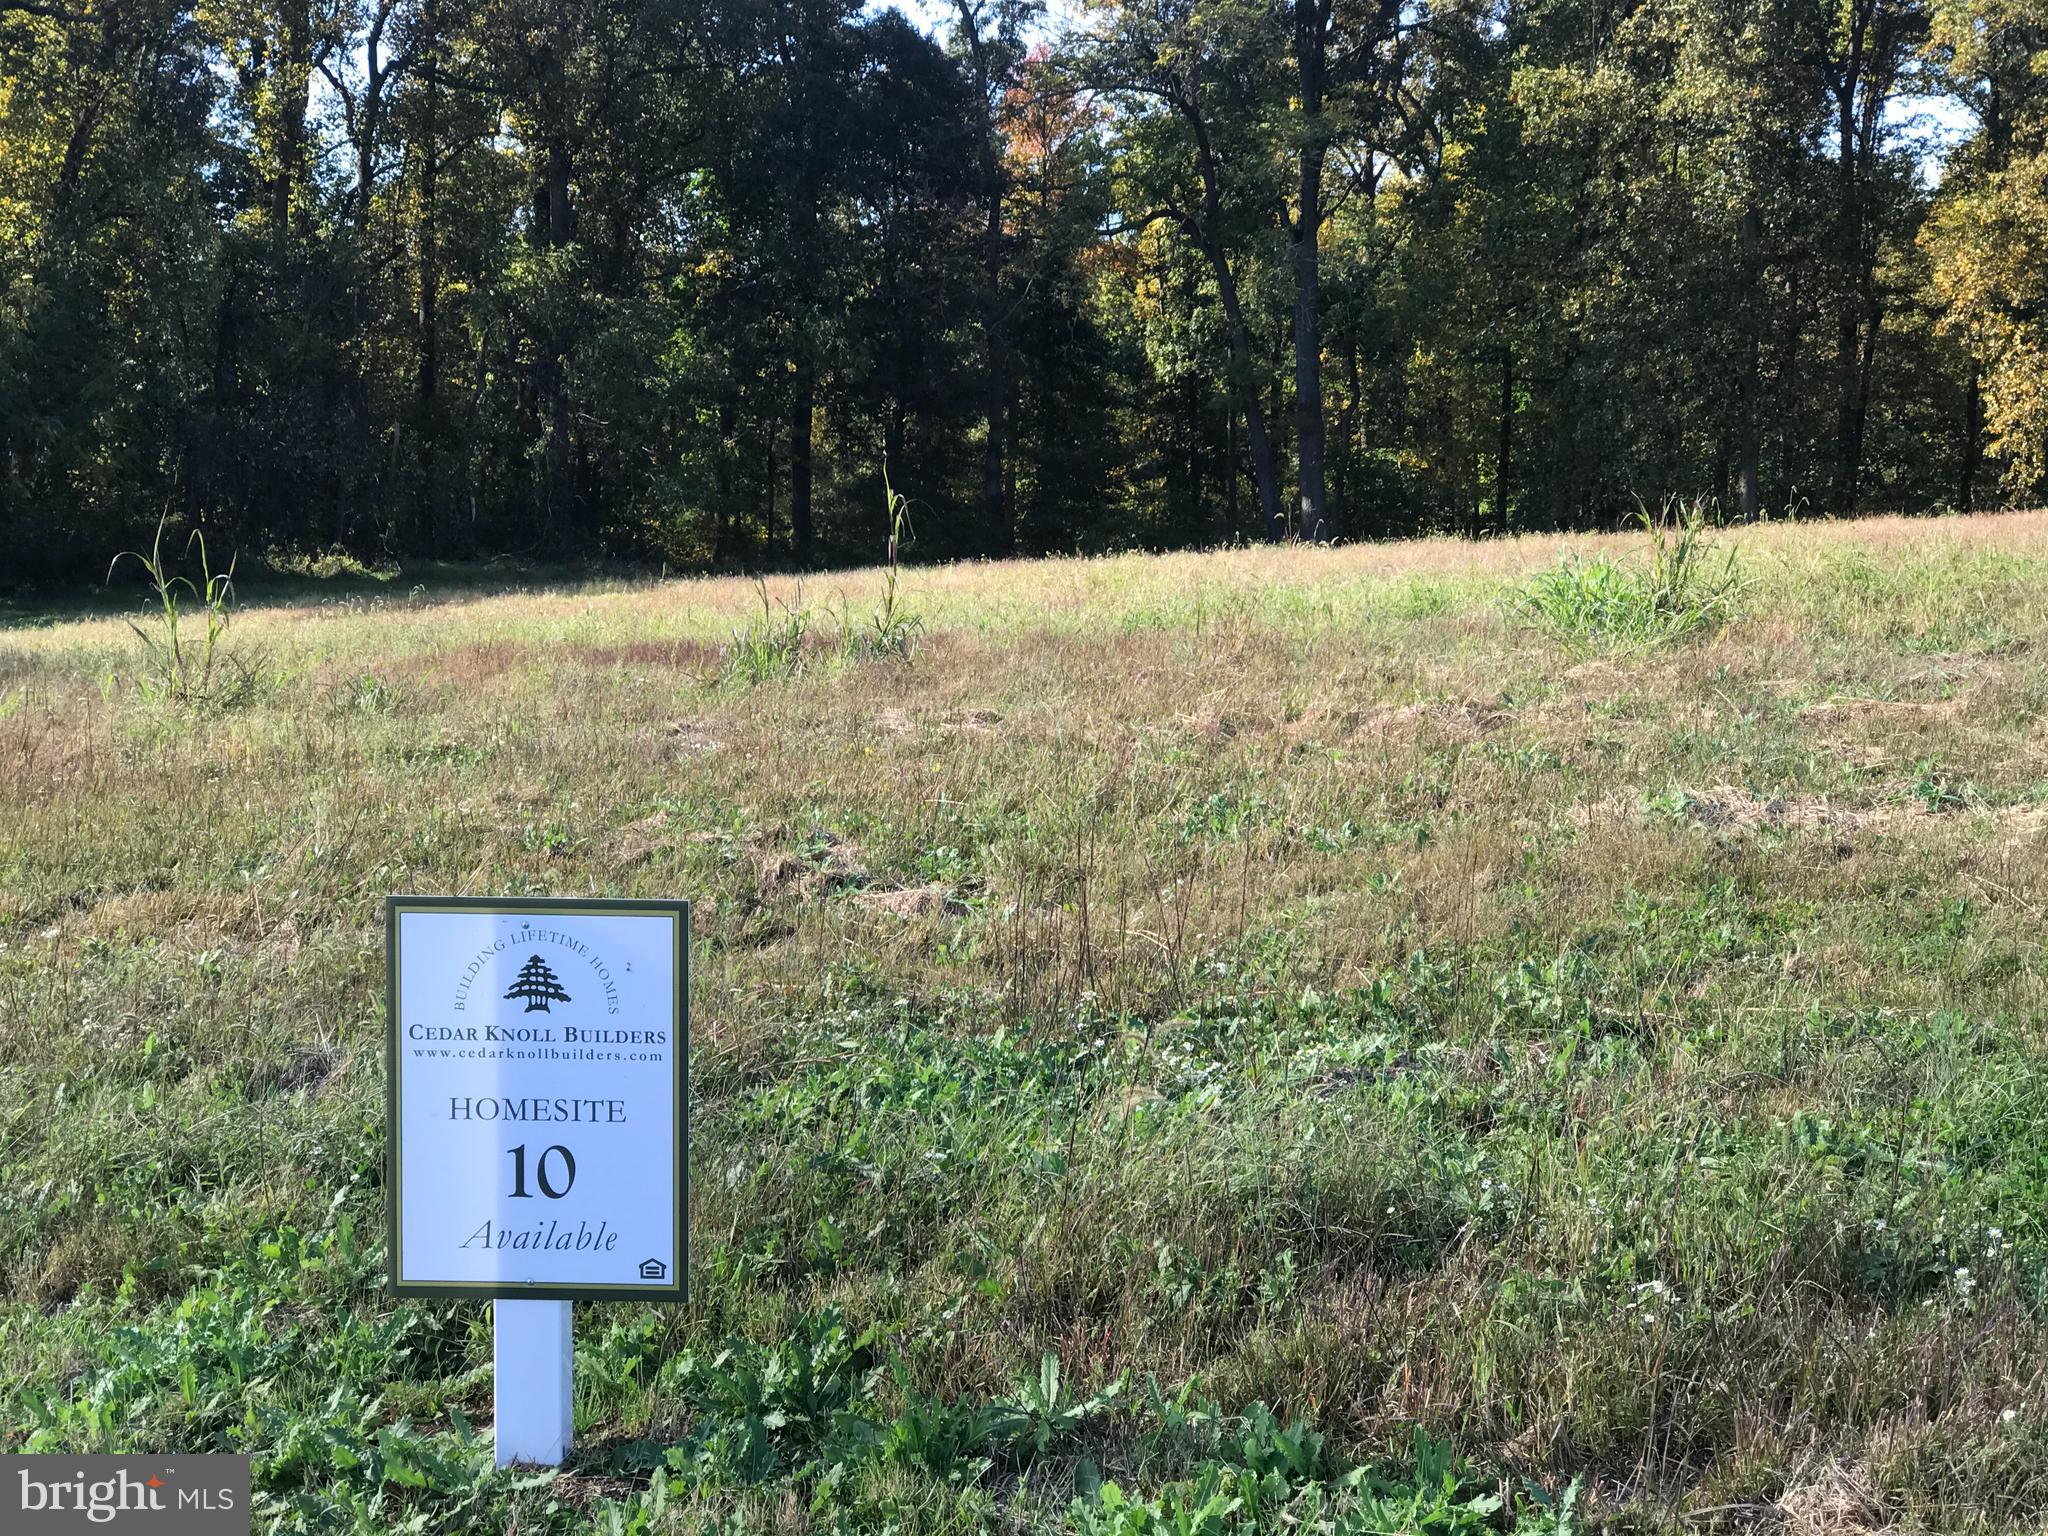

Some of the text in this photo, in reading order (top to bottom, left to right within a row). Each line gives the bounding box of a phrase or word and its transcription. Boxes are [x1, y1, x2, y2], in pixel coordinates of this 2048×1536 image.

[454, 929, 620, 1015] BUILDING LIFETIME HOMES
[413, 1047, 663, 1062] www.cedarknollbuilders.com
[449, 1097, 627, 1123] HOMESITE
[507, 1144, 576, 1199] 10
[459, 1219, 618, 1251] Available
